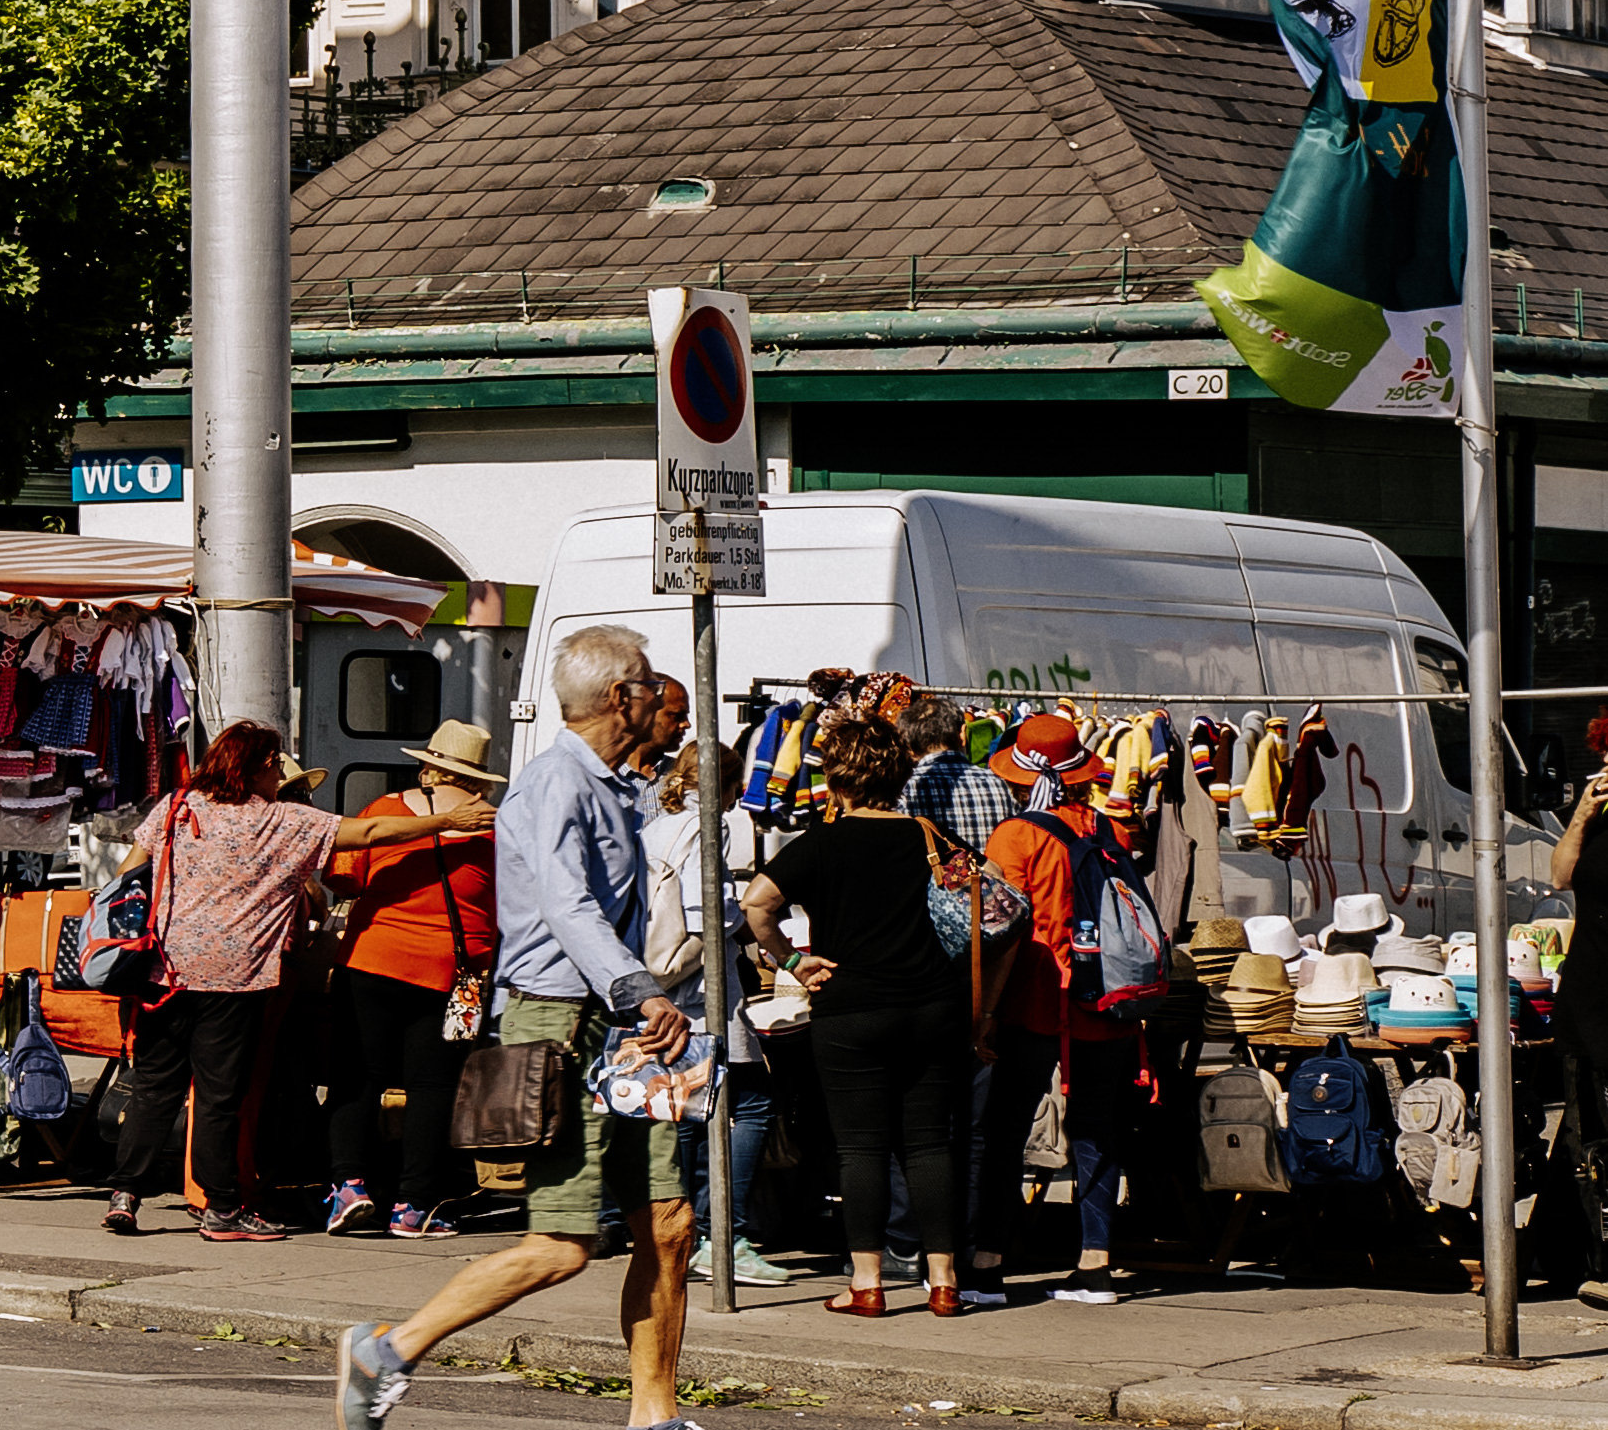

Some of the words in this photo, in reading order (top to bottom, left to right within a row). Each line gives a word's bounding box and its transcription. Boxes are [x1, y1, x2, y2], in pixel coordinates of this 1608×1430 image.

[1174, 375, 1189, 395] C
[1196, 375, 1223, 394] 20
[81, 459, 133, 495] WC
[667, 458, 754, 501] Kurzparkzone
[669, 521, 759, 543] gebührenpflichtig
[665, 546, 726, 564] Parkdauer:
[730, 548, 743, 566] 1,5
[745, 548, 763, 565] Std.
